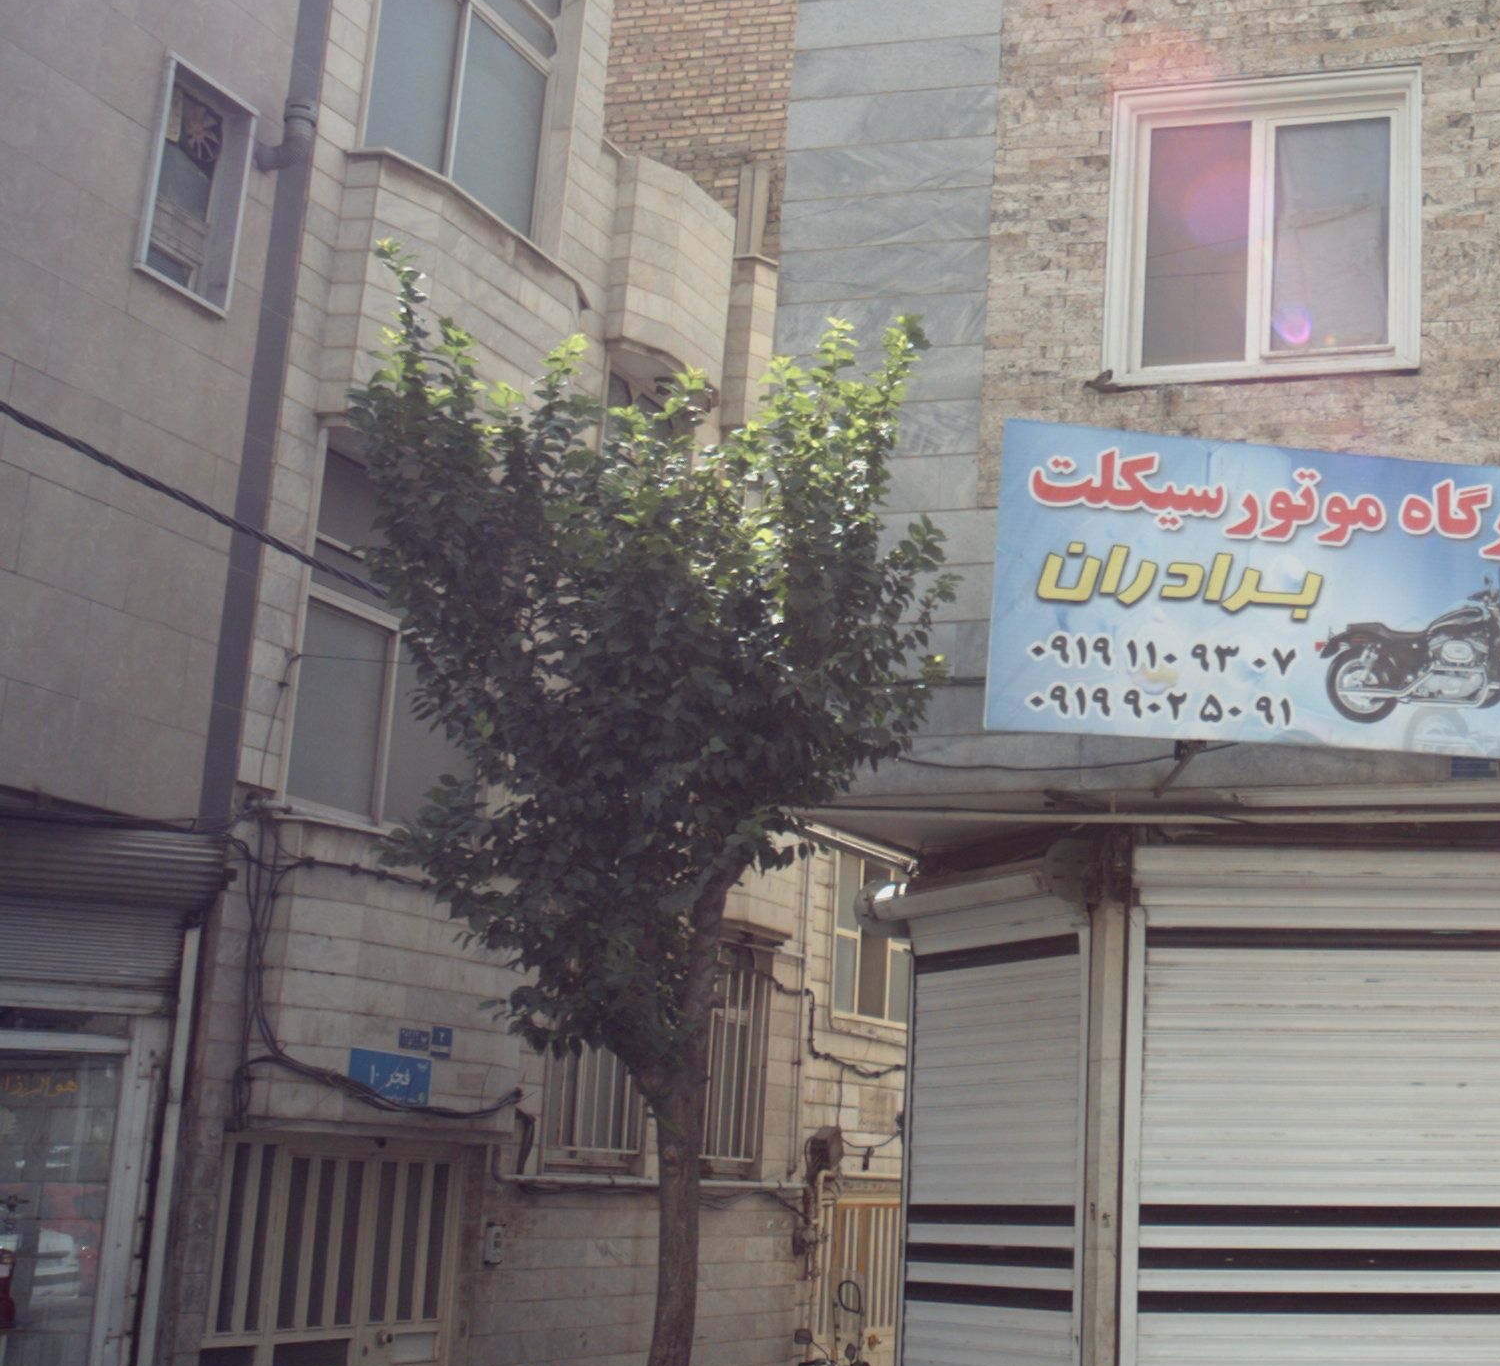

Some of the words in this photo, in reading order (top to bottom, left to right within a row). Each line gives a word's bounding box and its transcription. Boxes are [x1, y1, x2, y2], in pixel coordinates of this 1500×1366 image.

[1036, 541, 1324, 620] برادران
[1030, 634, 1112, 666] ۰۹۱۹
[1126, 639, 1178, 669] ۱۱۰
[1191, 643, 1240, 673] ۹۳
[1252, 647, 1297, 676] ۰۷
[1029, 685, 1111, 717] ۰۹۱۹
[1123, 689, 1188, 721] ۹۰۲
[1199, 693, 1243, 723] ۵۰
[1255, 695, 1292, 726] ۹۱
